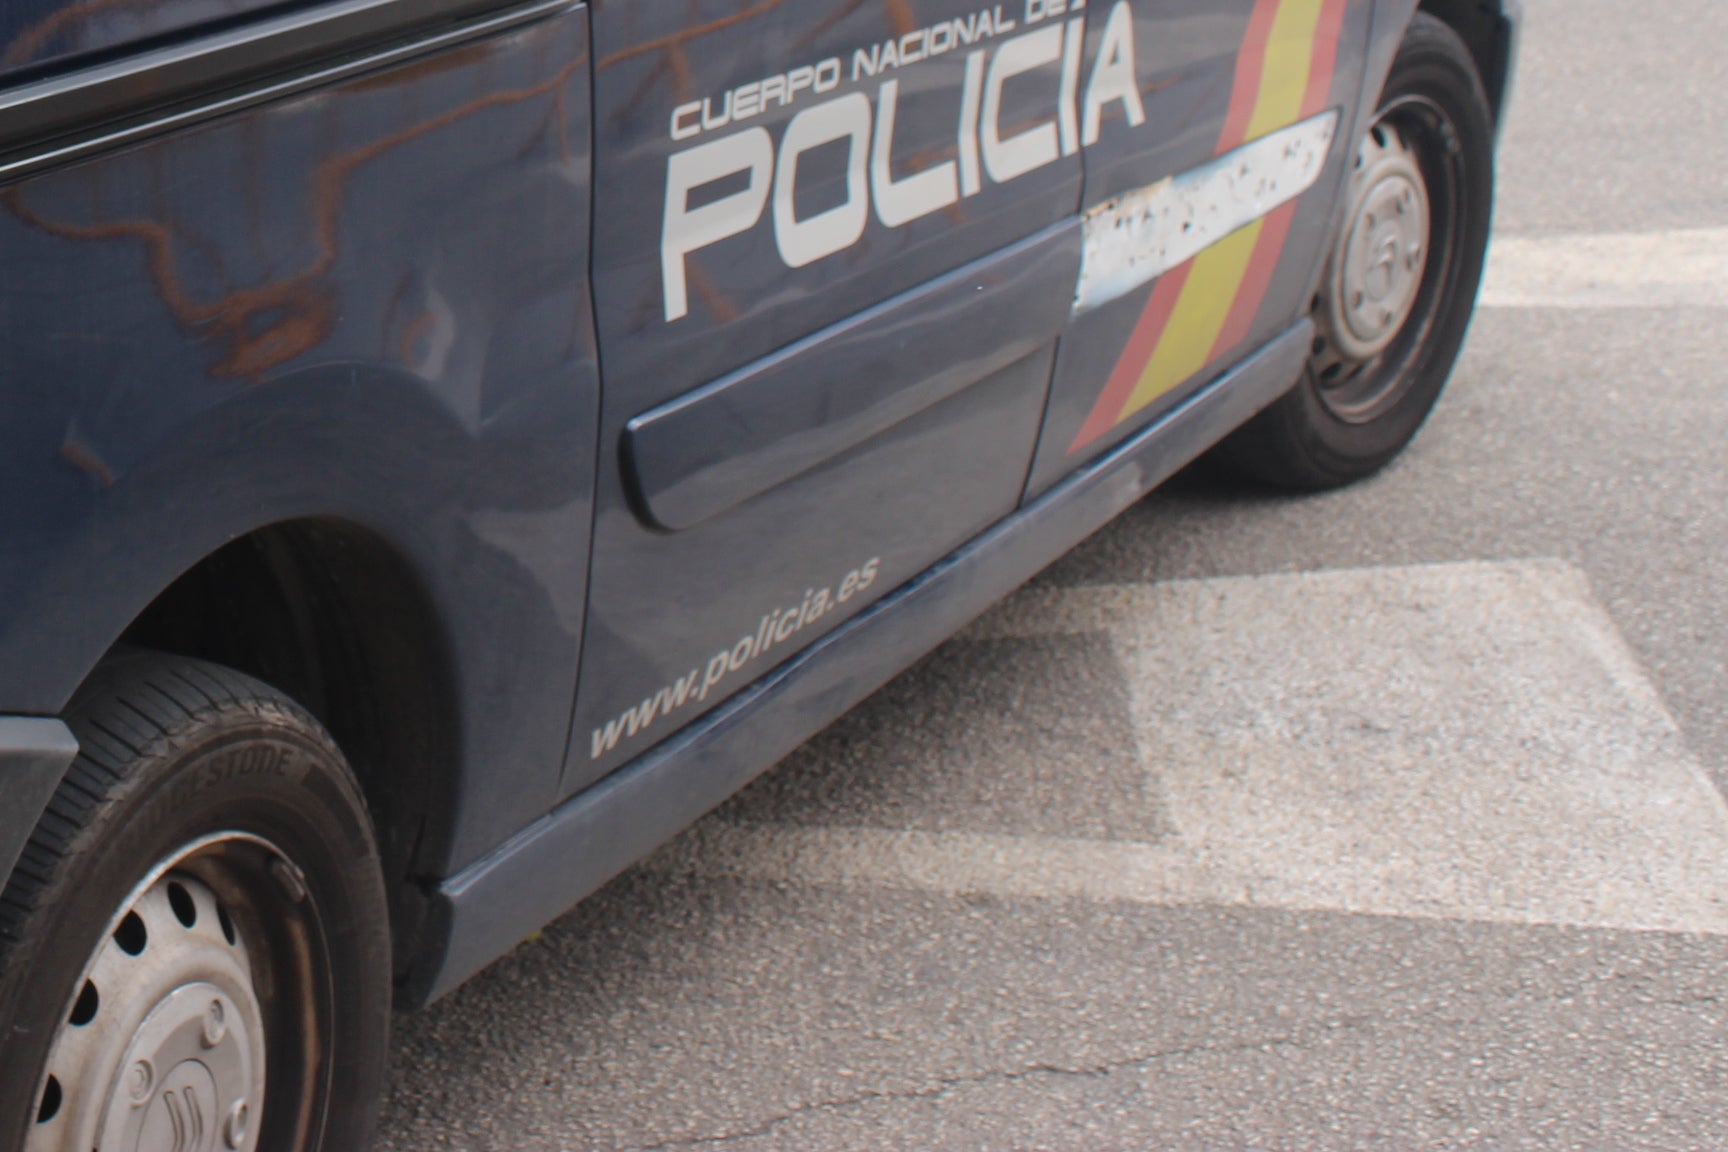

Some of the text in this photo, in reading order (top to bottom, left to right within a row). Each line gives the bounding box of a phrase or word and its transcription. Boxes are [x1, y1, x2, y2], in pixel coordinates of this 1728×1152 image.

[671, 57, 842, 141] CUERPO
[852, 5, 1016, 83] NACIONAL
[590, 556, 881, 760] www.policia.es
